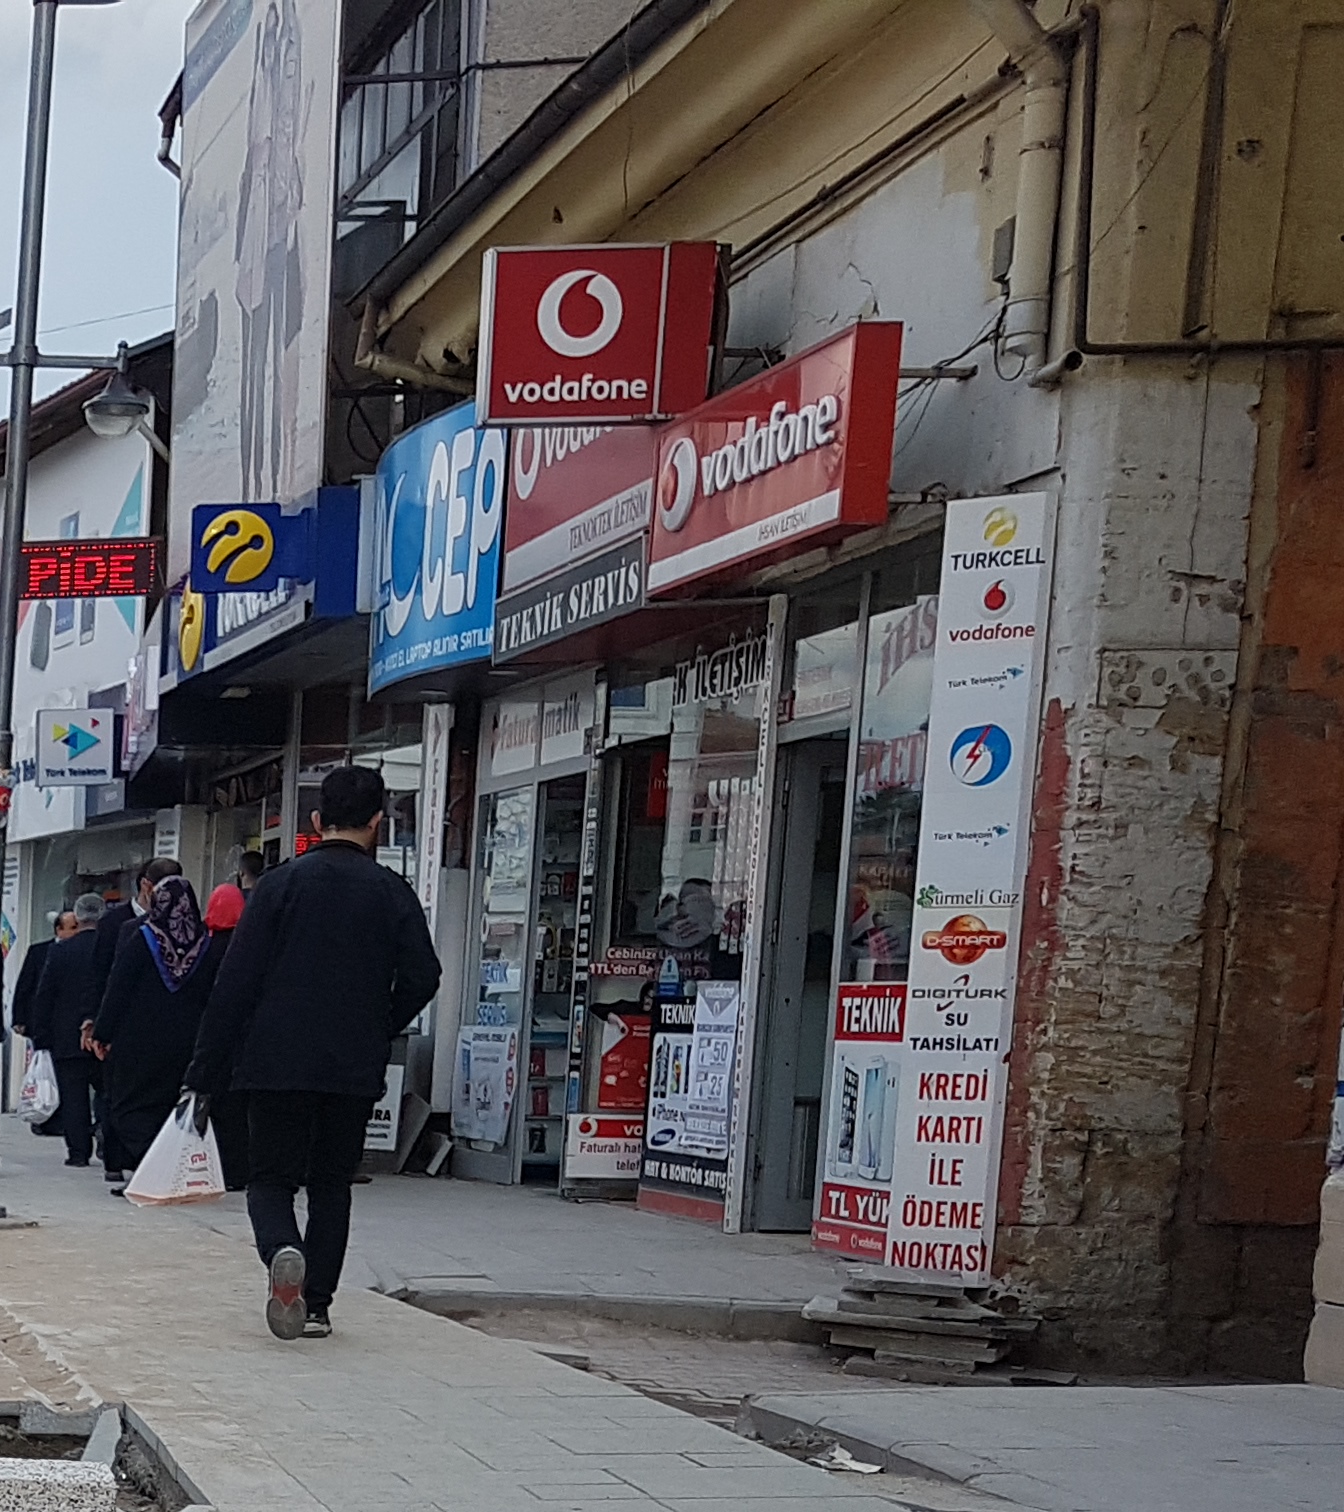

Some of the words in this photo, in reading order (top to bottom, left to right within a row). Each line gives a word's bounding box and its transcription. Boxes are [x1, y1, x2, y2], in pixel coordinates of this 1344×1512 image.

[503, 372, 648, 405] vodafone
[700, 394, 840, 497] vodafone
[422, 428, 505, 621] CEP
[28, 551, 136, 591] PİDE
[950, 547, 1045, 572] TURKCELL
[499, 592, 564, 653] TEKNİK
[567, 557, 640, 624] SERVİS
[948, 622, 1036, 644] vodafone
[947, 677, 967, 690] Türk
[969, 674, 1008, 687] Telekom
[45, 768, 66, 777] Türk
[68, 767, 108, 777] Telekom
[933, 831, 952, 843] Türk
[988, 889, 1020, 905] Gaz
[926, 935, 1001, 947] D-SMART
[660, 998, 696, 1025] TEKNİK
[840, 989, 903, 1035] TEKNİK
[944, 1011, 969, 1028] SU
[713, 1037, 729, 1063] 50
[909, 1035, 1000, 1053] TAHSİLATI
[710, 1072, 725, 1097] 25
[918, 1068, 989, 1102] KREDİ
[916, 1116, 984, 1144] KARTI
[579, 1141, 621, 1155] Faturalı
[928, 1153, 965, 1187] İLE
[828, 1189, 850, 1218] TL
[901, 1195, 984, 1230] ÖDEME
[891, 1240, 988, 1272] NOKTASI
